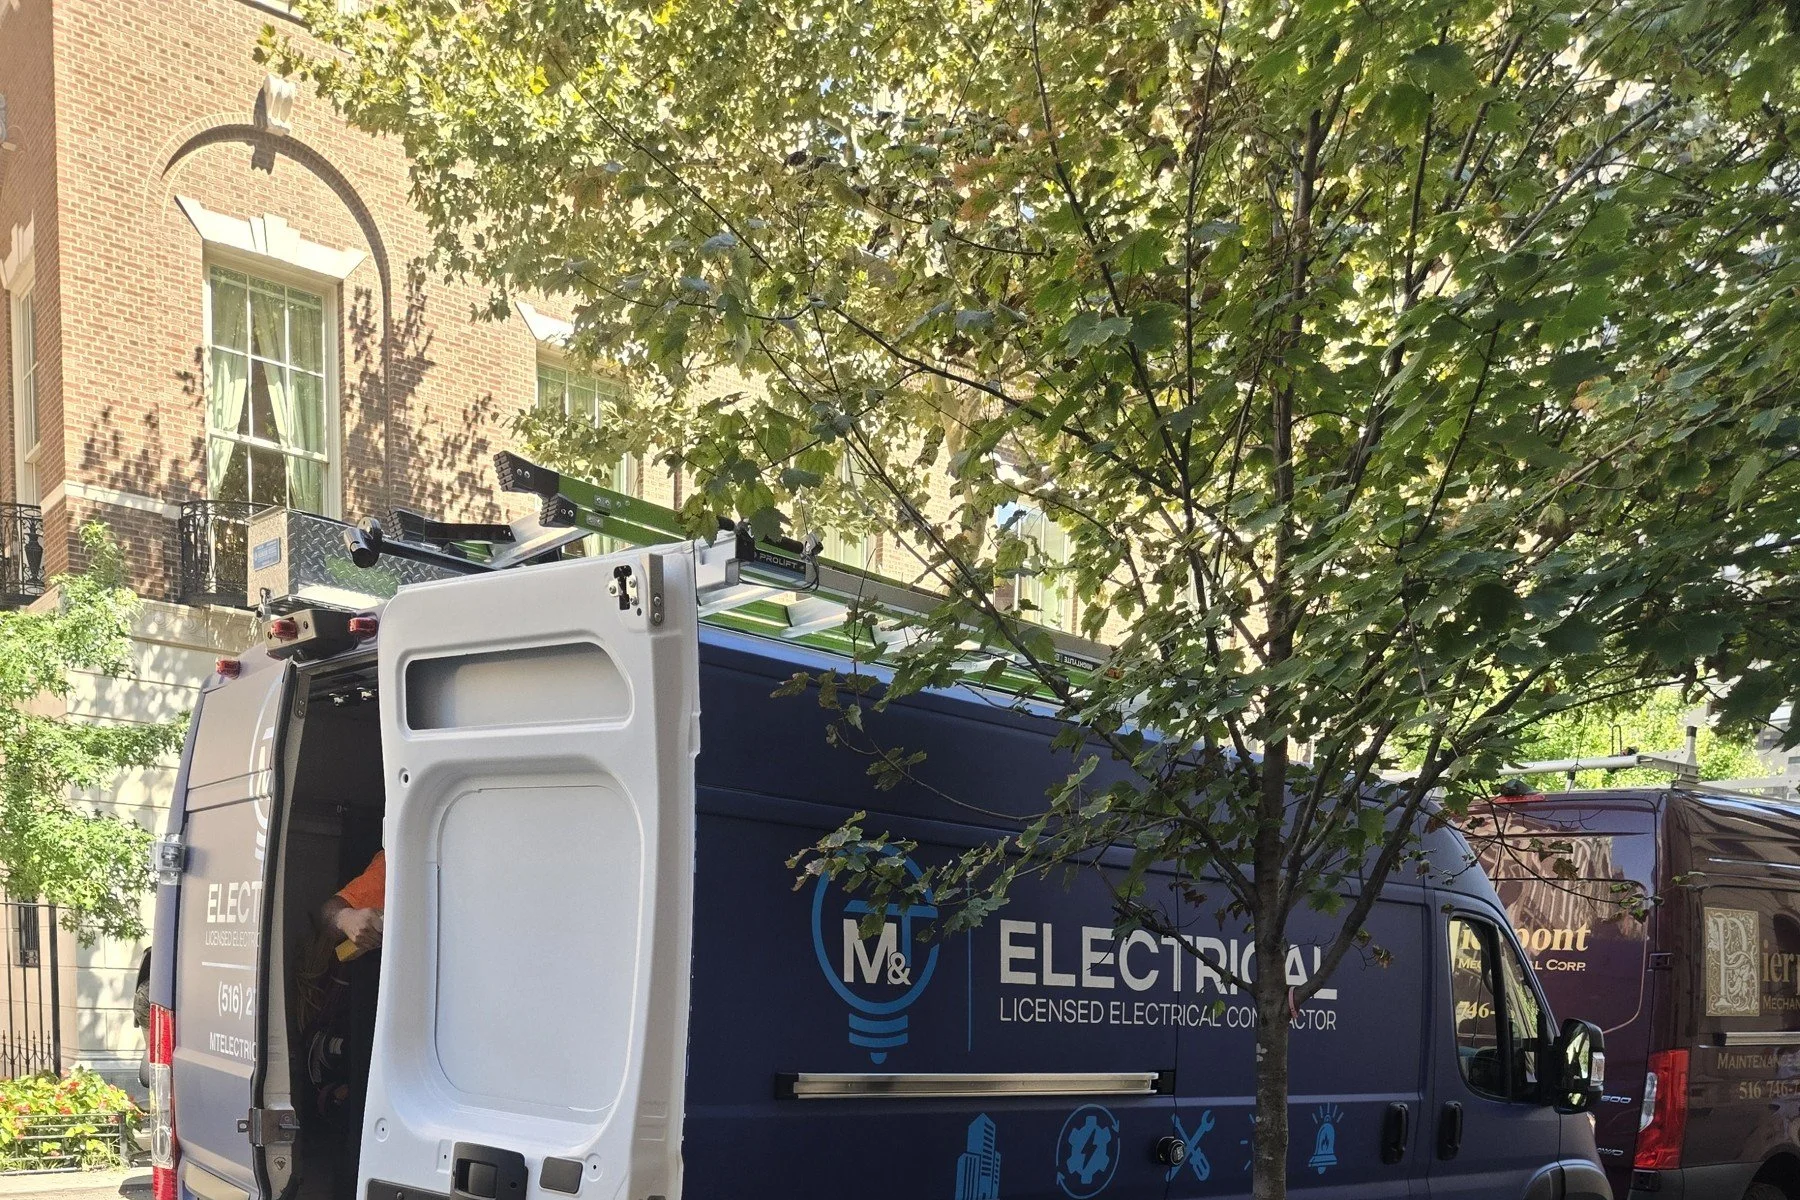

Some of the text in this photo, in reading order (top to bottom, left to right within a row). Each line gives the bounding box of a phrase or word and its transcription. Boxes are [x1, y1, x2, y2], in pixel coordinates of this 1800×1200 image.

[759, 552, 798, 570] PROLIFT
[205, 929, 232, 947] LICENSED
[218, 981, 243, 1020] (516)
[1000, 997, 1337, 1031] LICENSED ELECTRICAL CONCTOR
[1739, 1080, 1762, 1100] 516
